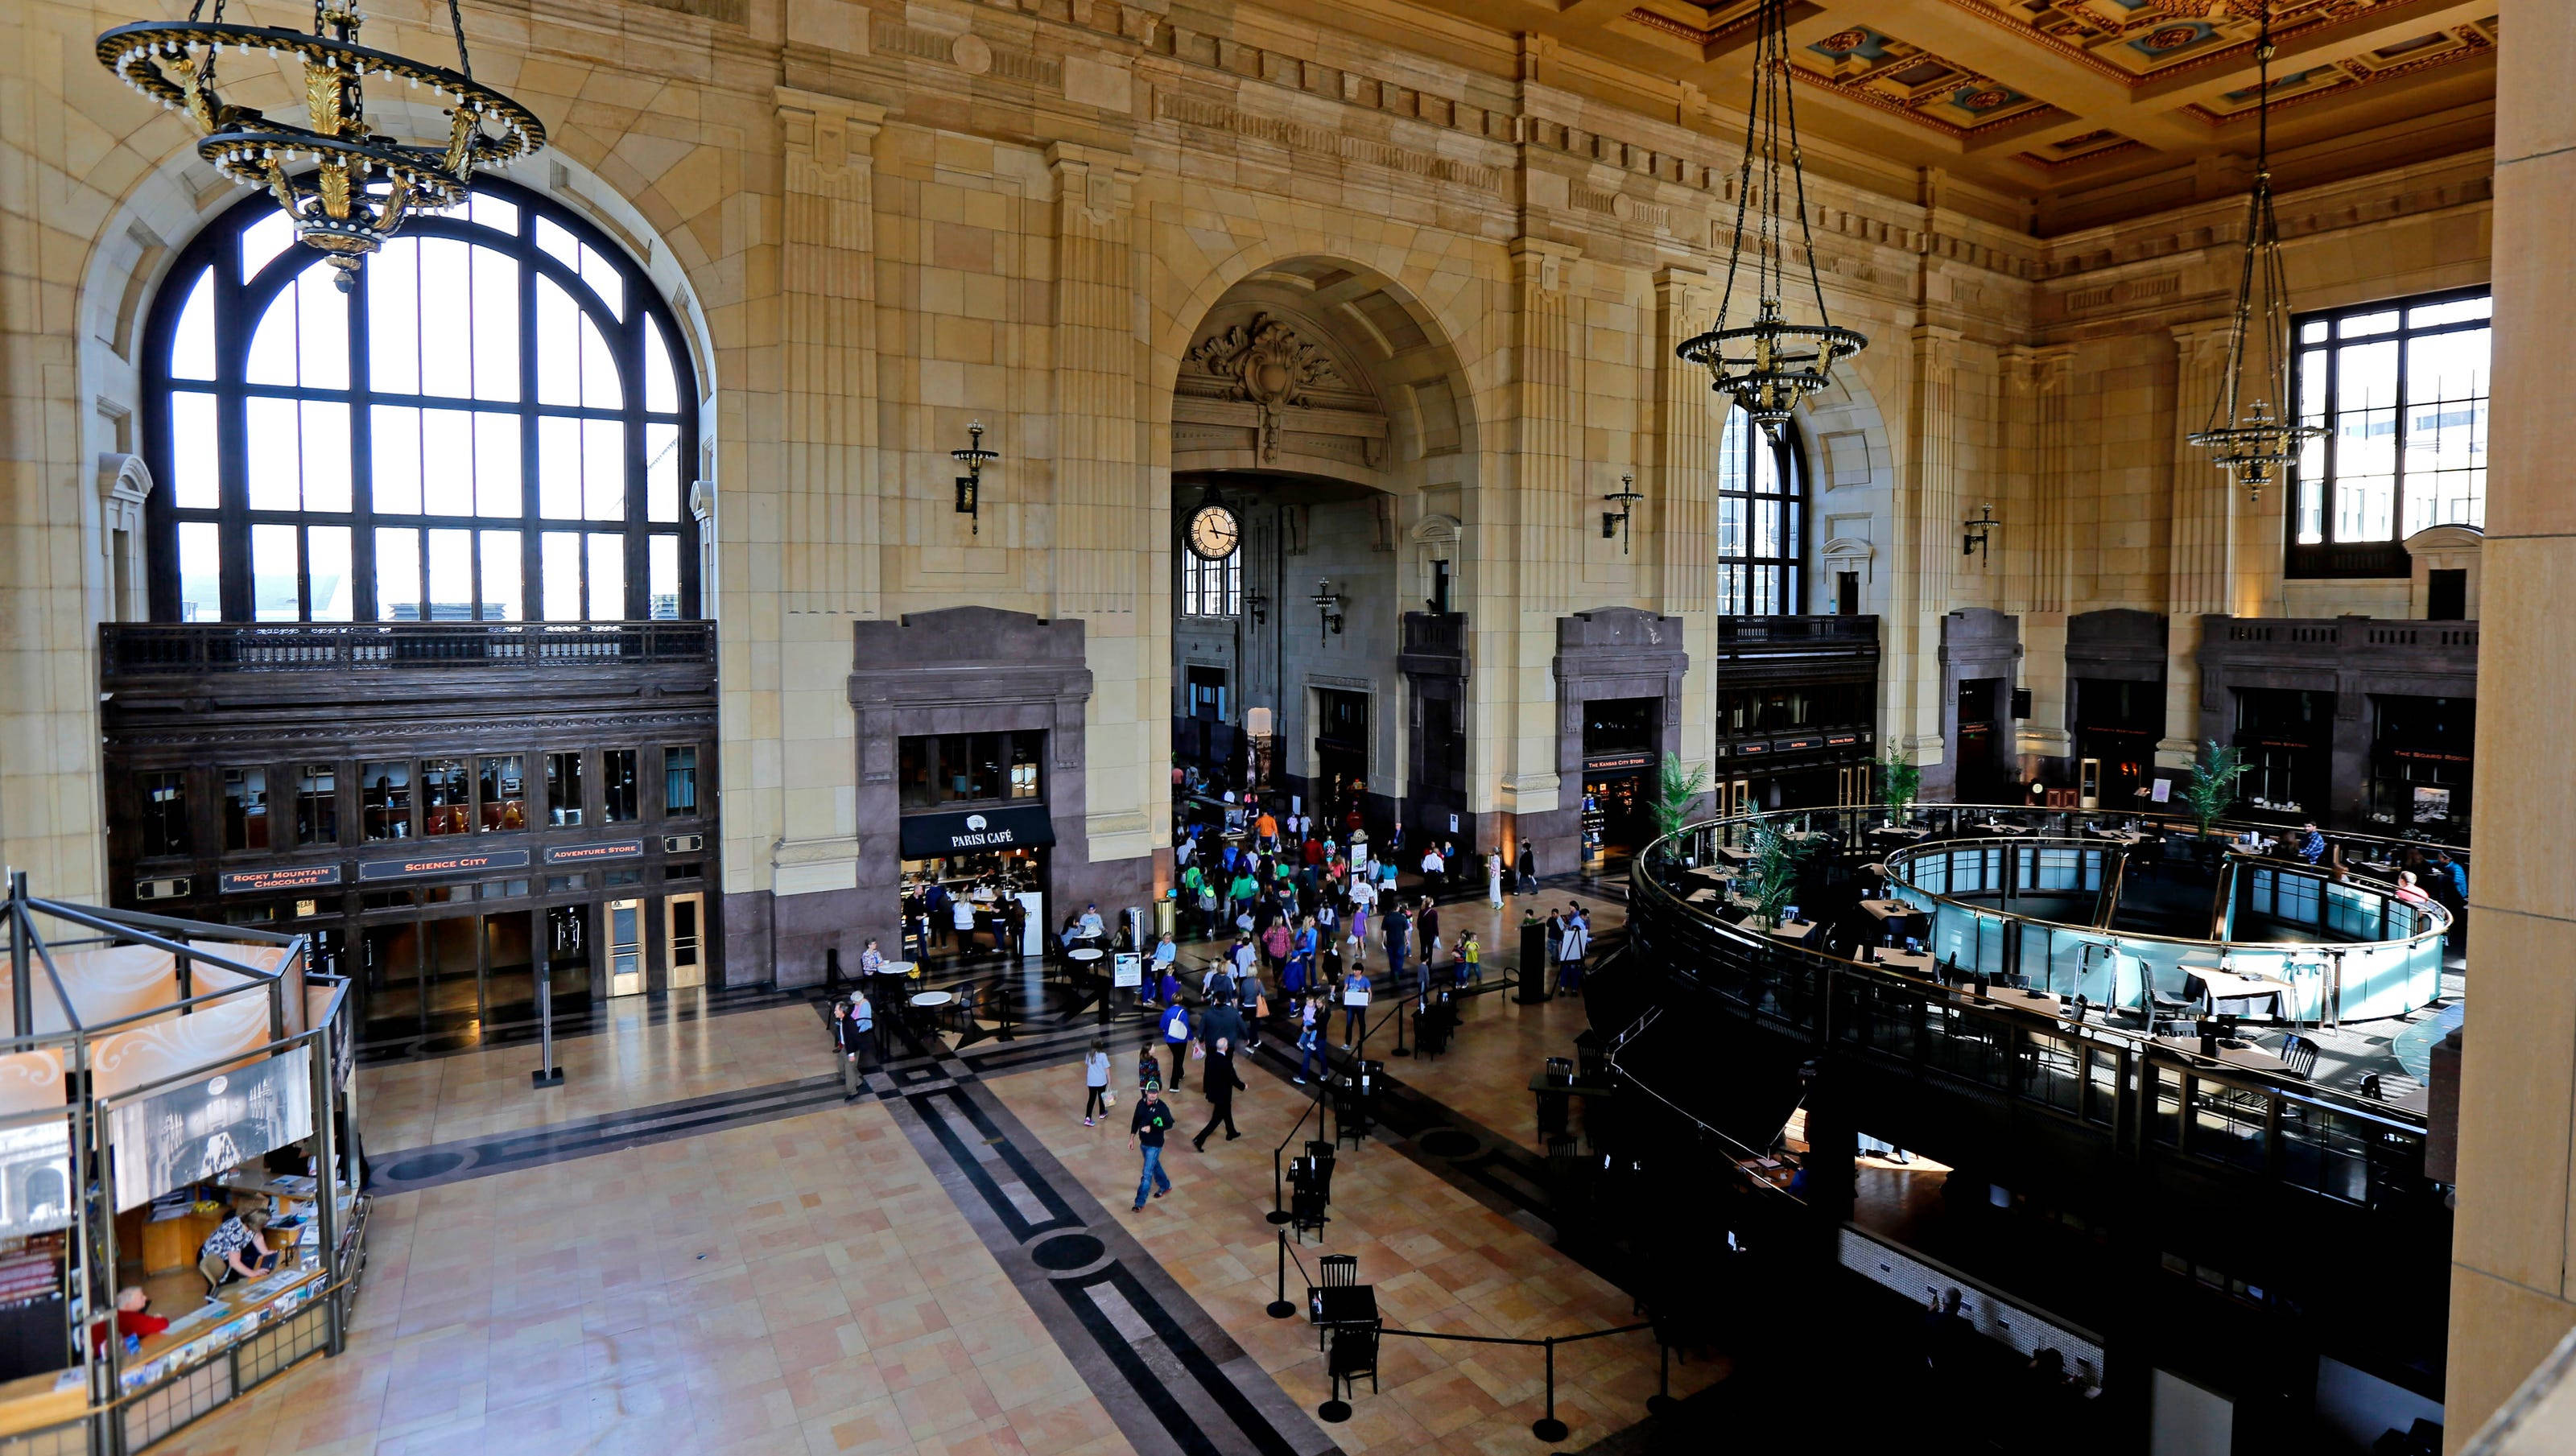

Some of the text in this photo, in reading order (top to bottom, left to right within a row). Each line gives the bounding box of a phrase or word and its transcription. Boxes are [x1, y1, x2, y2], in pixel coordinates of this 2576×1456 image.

[952, 829, 1013, 848] PARISI CAFÉ
[553, 846, 636, 859] ADVENTURE STORE
[405, 857, 488, 871] SCIENCE CITY
[233, 868, 329, 882] ROCKY MOUNTAIN
[254, 876, 318, 889] CHOCOLATE
